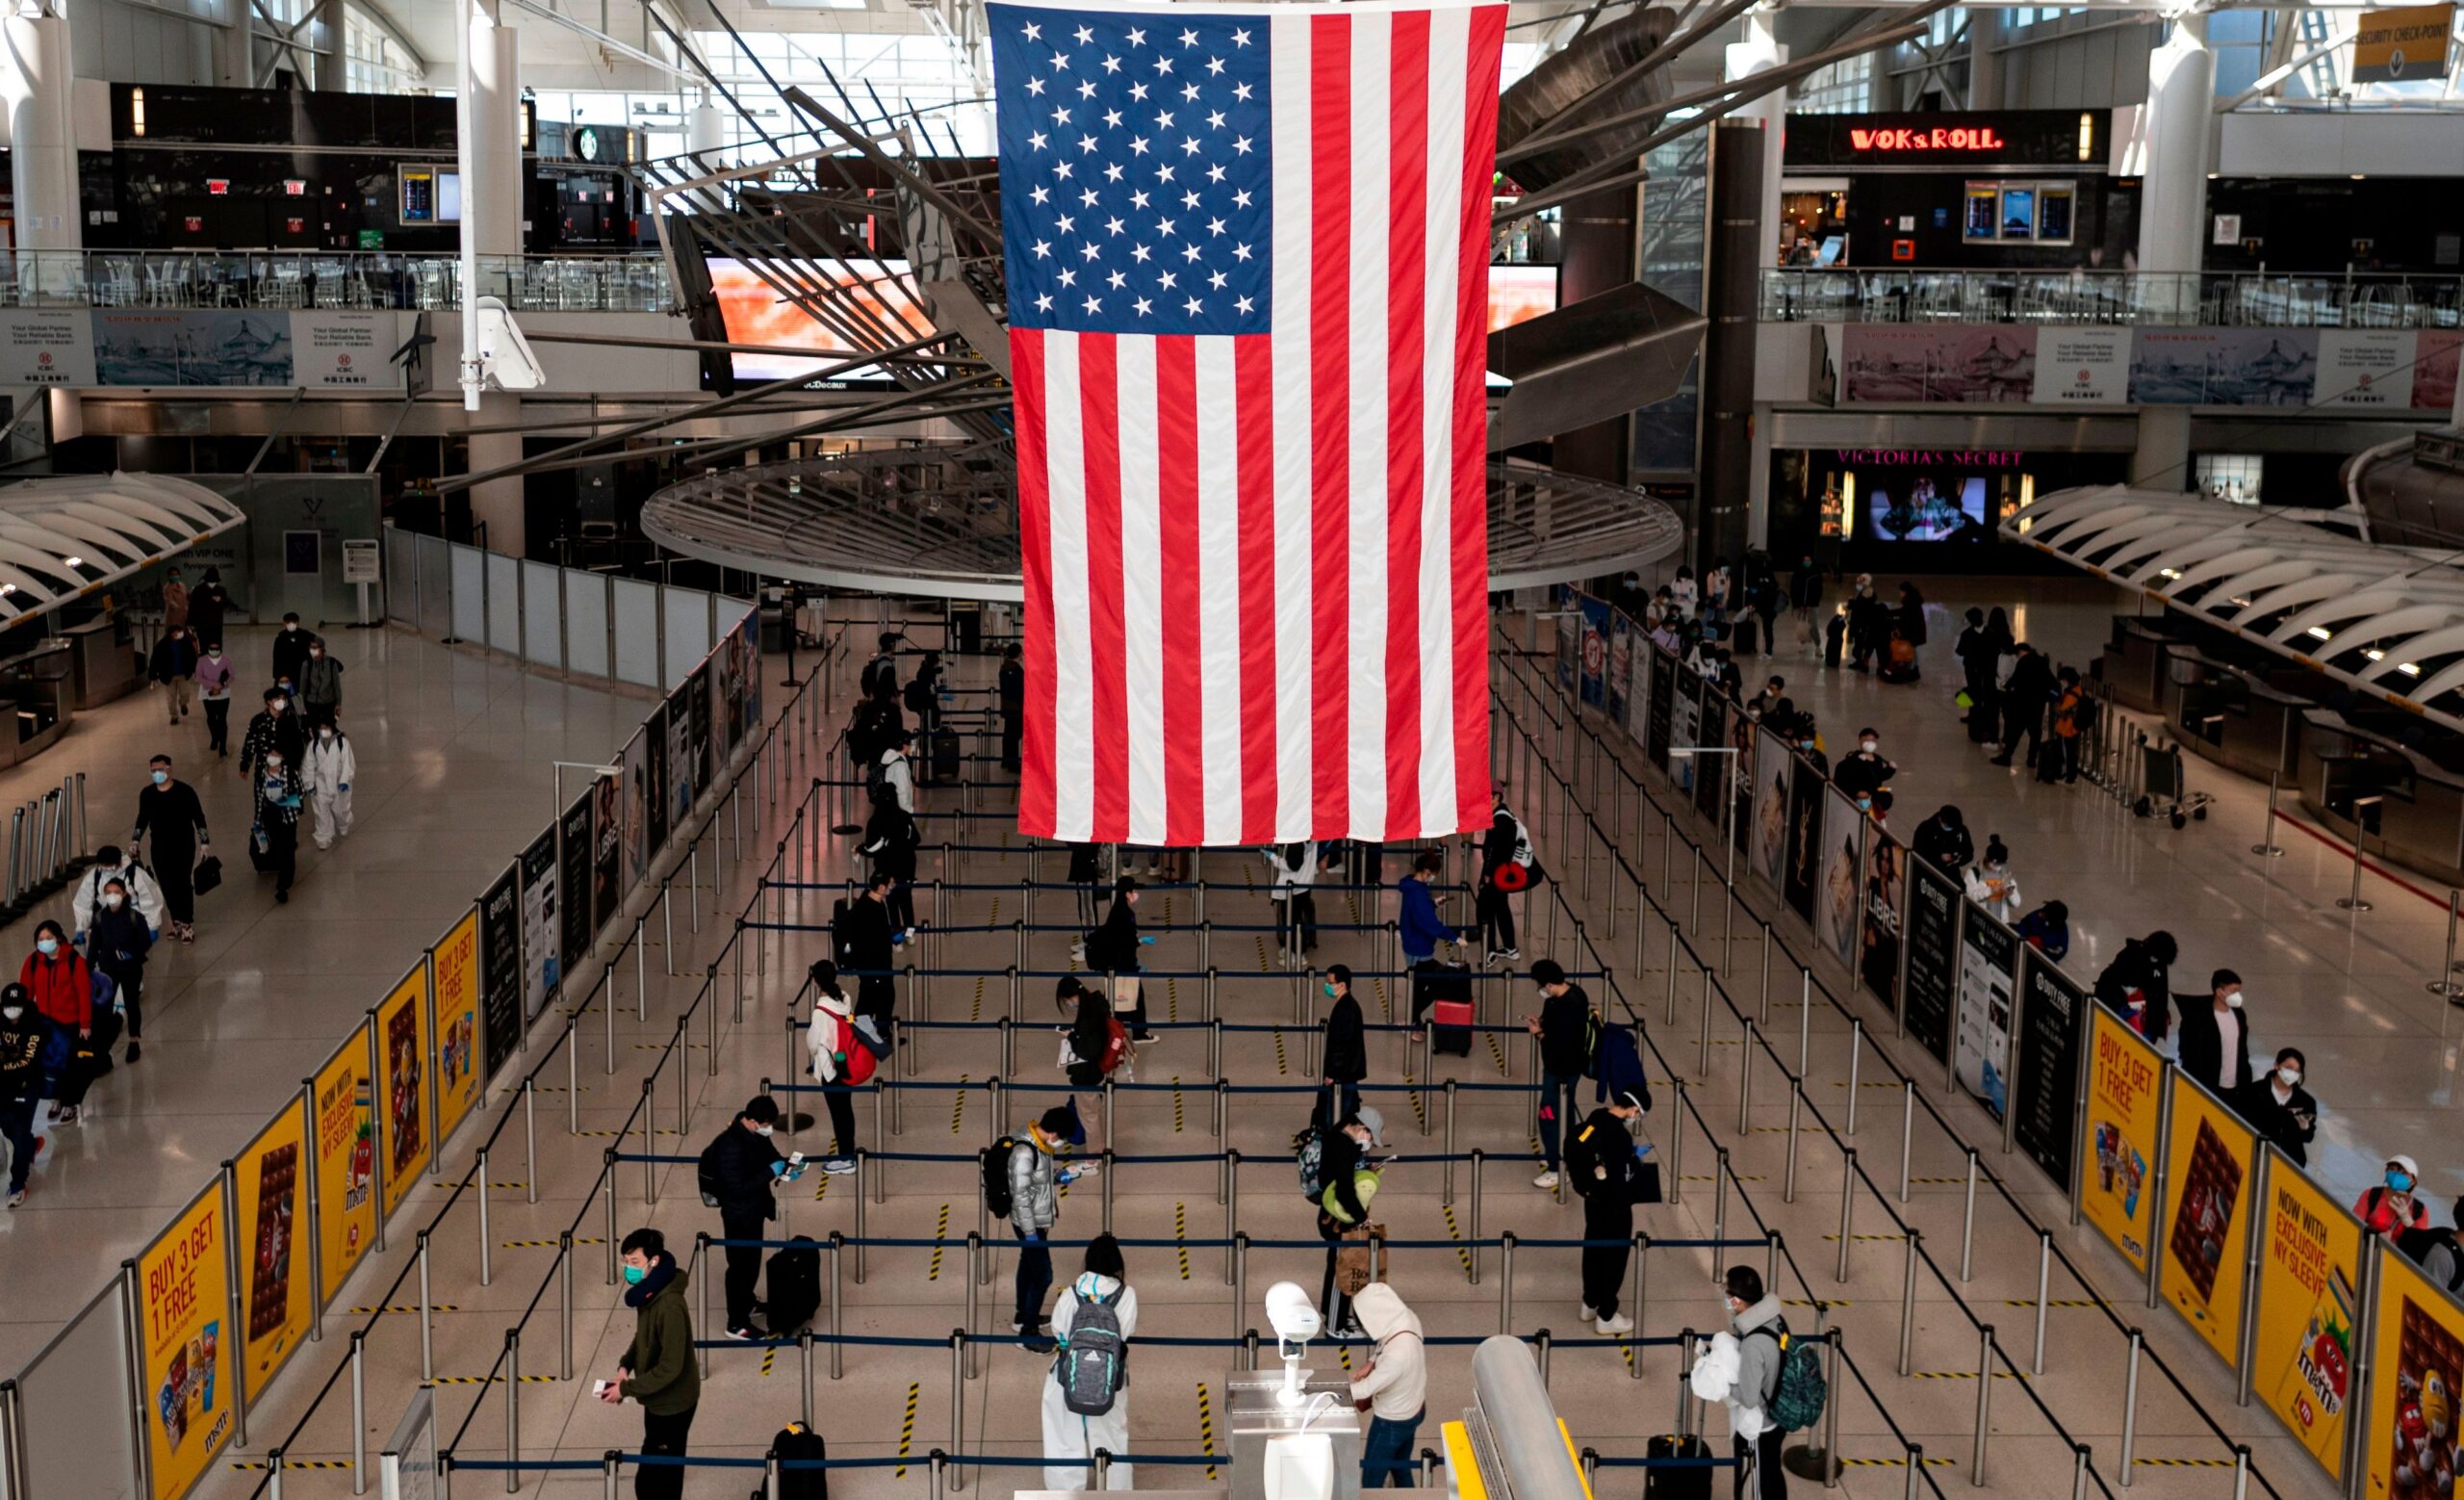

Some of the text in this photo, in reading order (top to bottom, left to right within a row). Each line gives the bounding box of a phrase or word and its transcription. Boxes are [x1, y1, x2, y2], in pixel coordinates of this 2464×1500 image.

[2357, 28, 2391, 46] SECURITY
[1835, 449, 2022, 468] VICTORIA'S SECRET
[213, 549, 234, 557] ONE
[597, 821, 617, 863] LIBRE
[1868, 888, 1899, 935] LIBRE
[439, 952, 451, 985] BUY
[460, 934, 472, 965] GET
[446, 969, 463, 1007] FREE
[2043, 978, 2058, 1003] DUTY
[2058, 990, 2071, 1013] FREE
[2099, 1031, 2153, 1097] BUY 3 GET
[2099, 1061, 2104, 1087] 1
[2106, 1069, 2133, 1114] FREE
[321, 1064, 352, 1117] NOW WITH
[322, 1086, 354, 1138] EXCLUSIVE
[322, 1108, 355, 1164] NY SLEEVE
[2278, 1186, 2327, 1249] NOW WITH
[150, 1209, 215, 1306] BUY 3 GET
[2273, 1236, 2325, 1301] NY SLEEVE
[2276, 1212, 2327, 1277] EXCLUSIVE
[153, 1265, 197, 1341] 1 FREE
